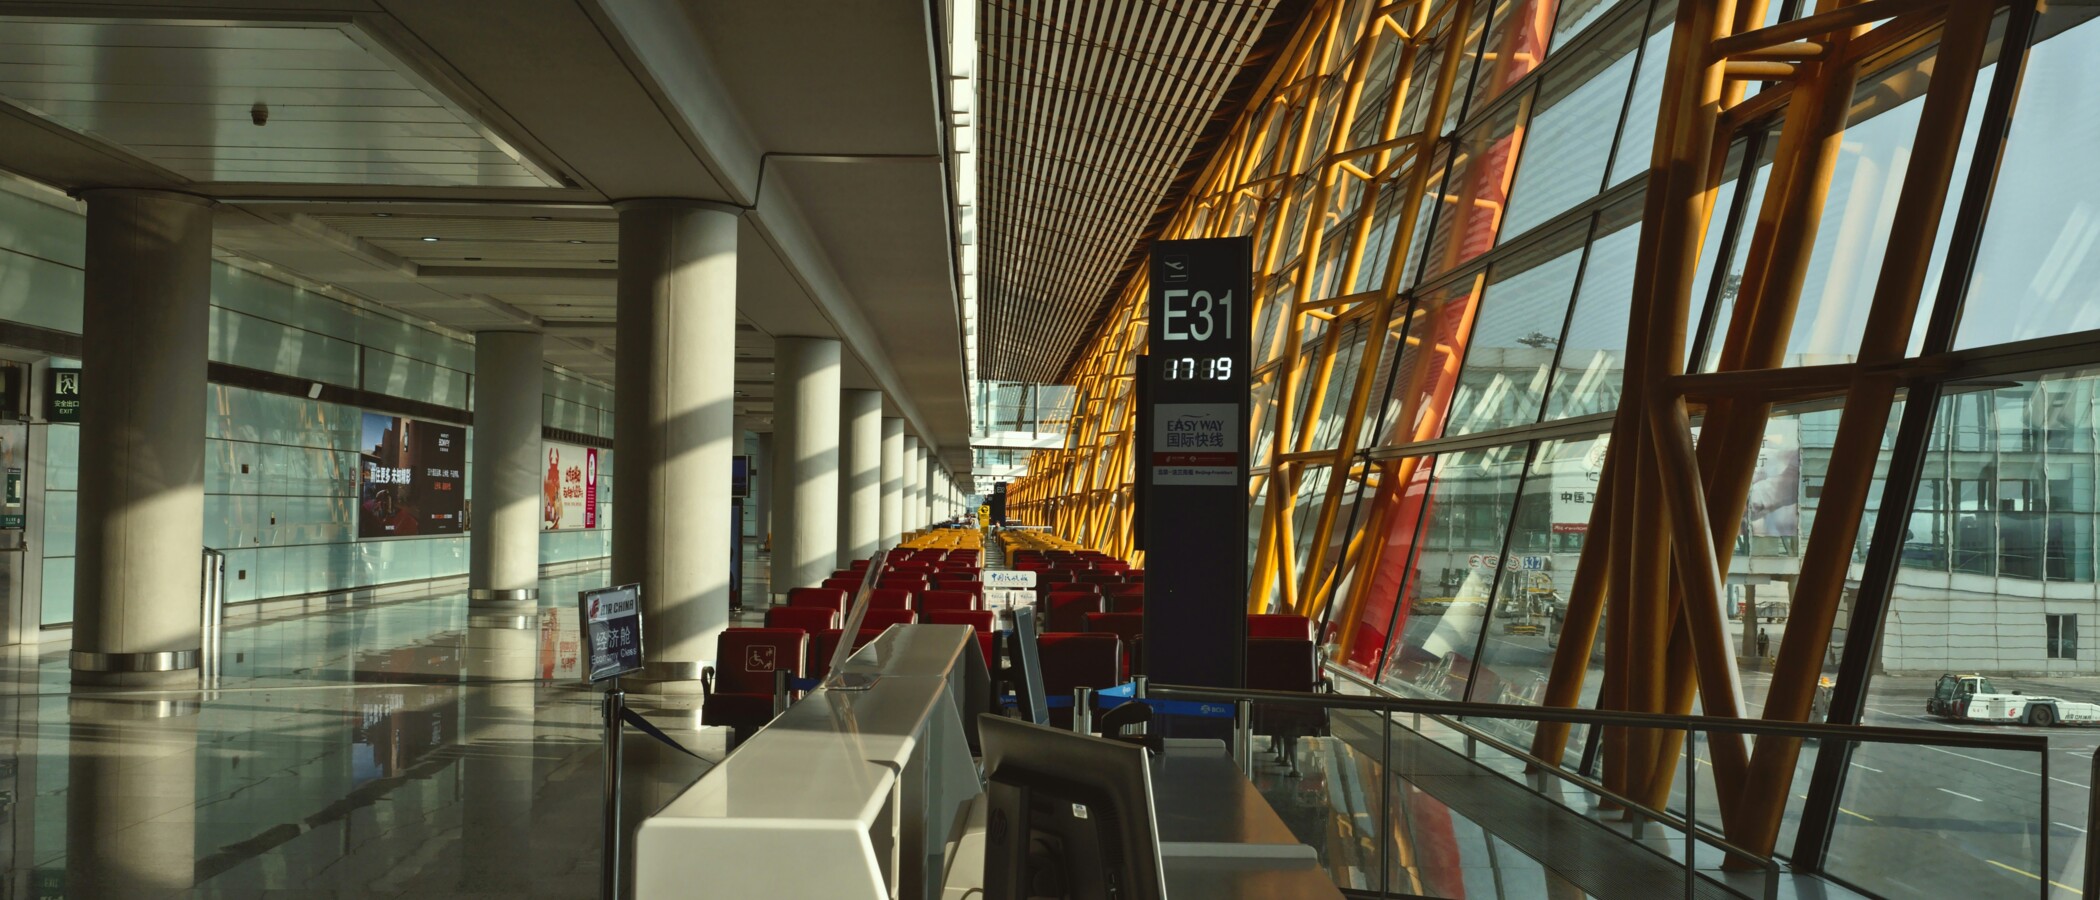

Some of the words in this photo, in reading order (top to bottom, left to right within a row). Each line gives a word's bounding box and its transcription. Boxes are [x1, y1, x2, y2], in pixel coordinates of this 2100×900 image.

[1164, 289, 1232, 341] E31
[54, 400, 80, 408] 安全出口
[1167, 418, 1198, 432] EASY
[1199, 420, 1224, 432] WAY
[1167, 432, 1224, 448] 国际快线
[1585, 471, 1600, 482] IC
[600, 602, 612, 616] AIR
[613, 599, 634, 614] CHINA
[596, 625, 631, 651] 经济舱
[591, 651, 619, 665] Economy
[621, 647, 637, 658] Class
[1211, 706, 1226, 714] BCIA
